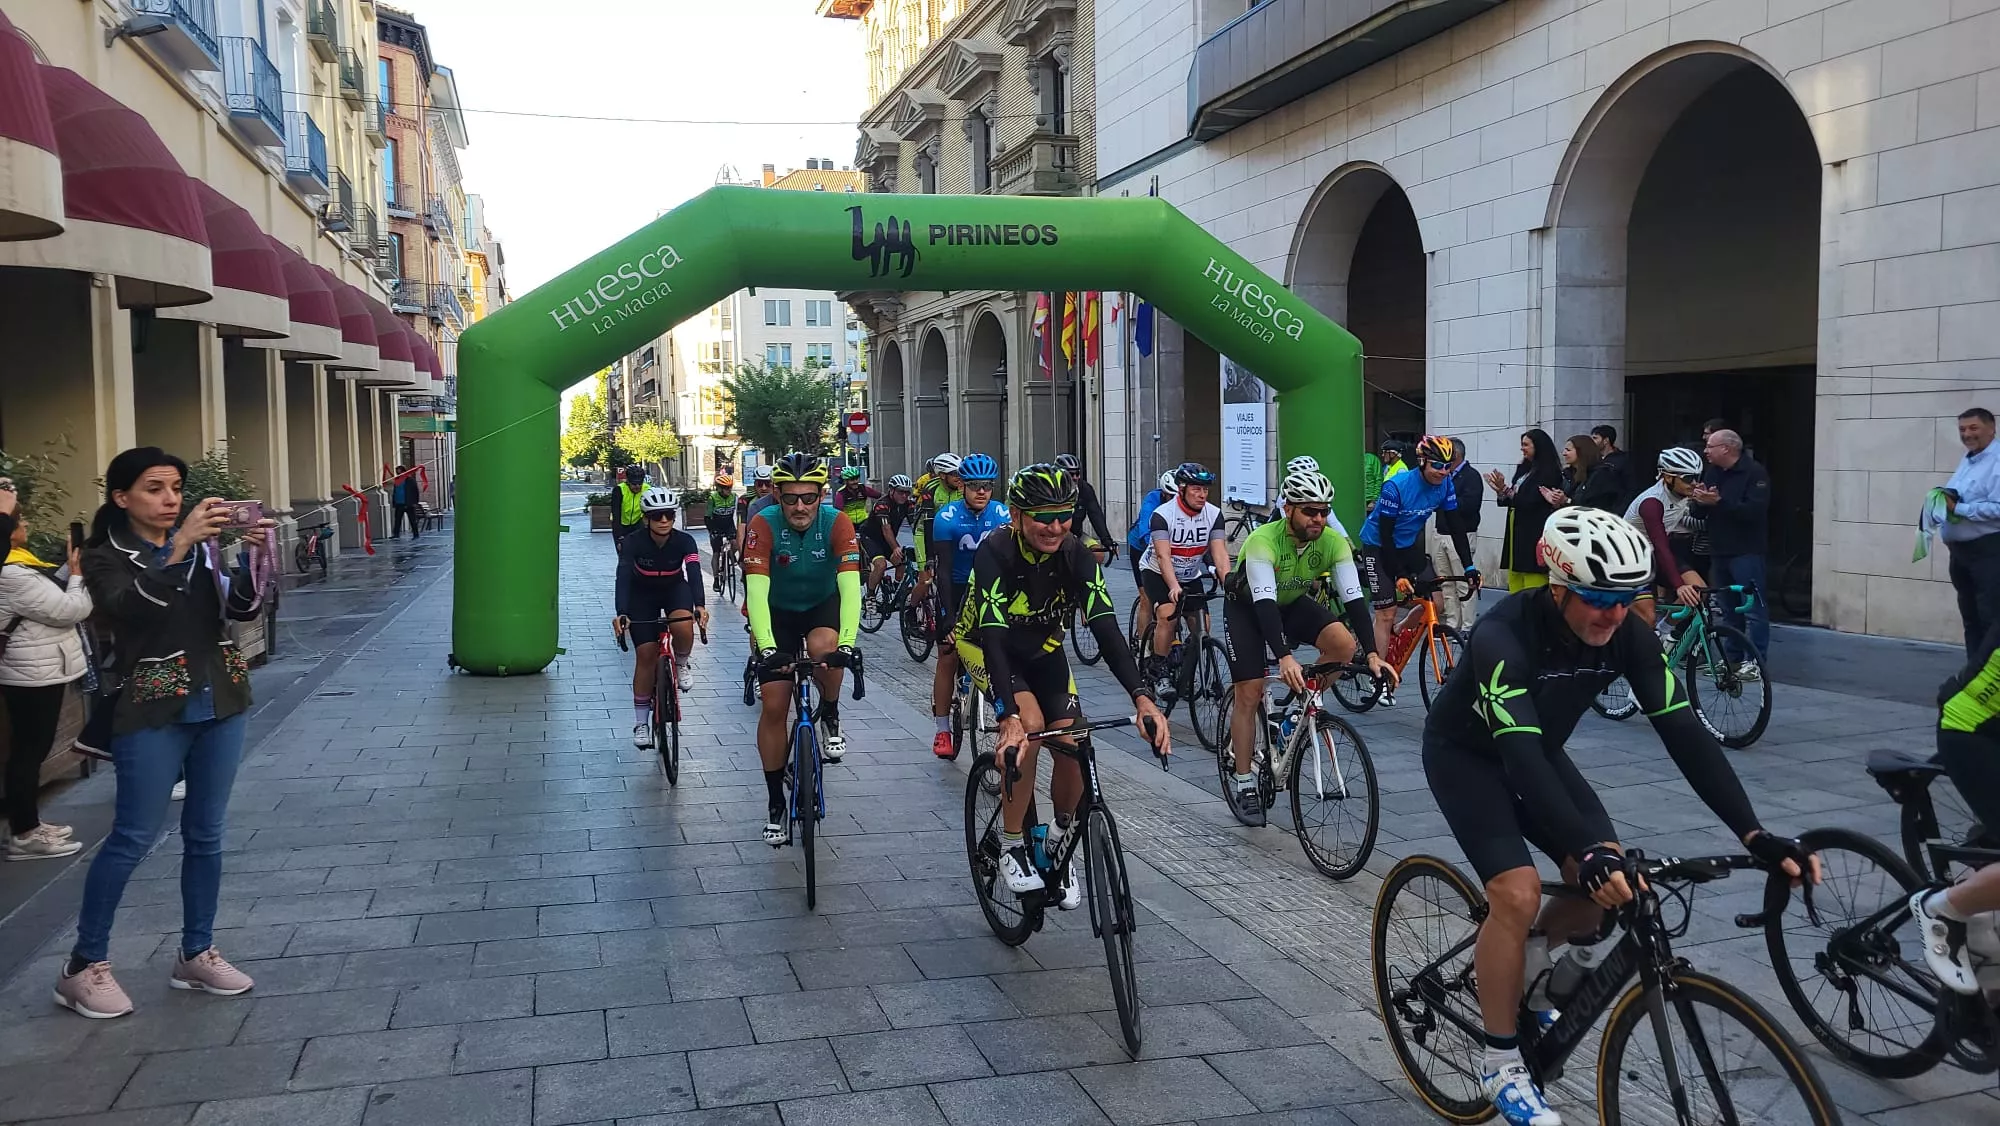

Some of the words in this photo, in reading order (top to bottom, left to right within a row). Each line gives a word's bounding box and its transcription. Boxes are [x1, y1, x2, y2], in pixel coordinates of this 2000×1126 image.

[929, 224, 1058, 246] PIRINEOS
[1236, 412, 1254, 422] VIAJES
[1171, 526, 1208, 544] UAE
[1053, 812, 1081, 871] LOOK
